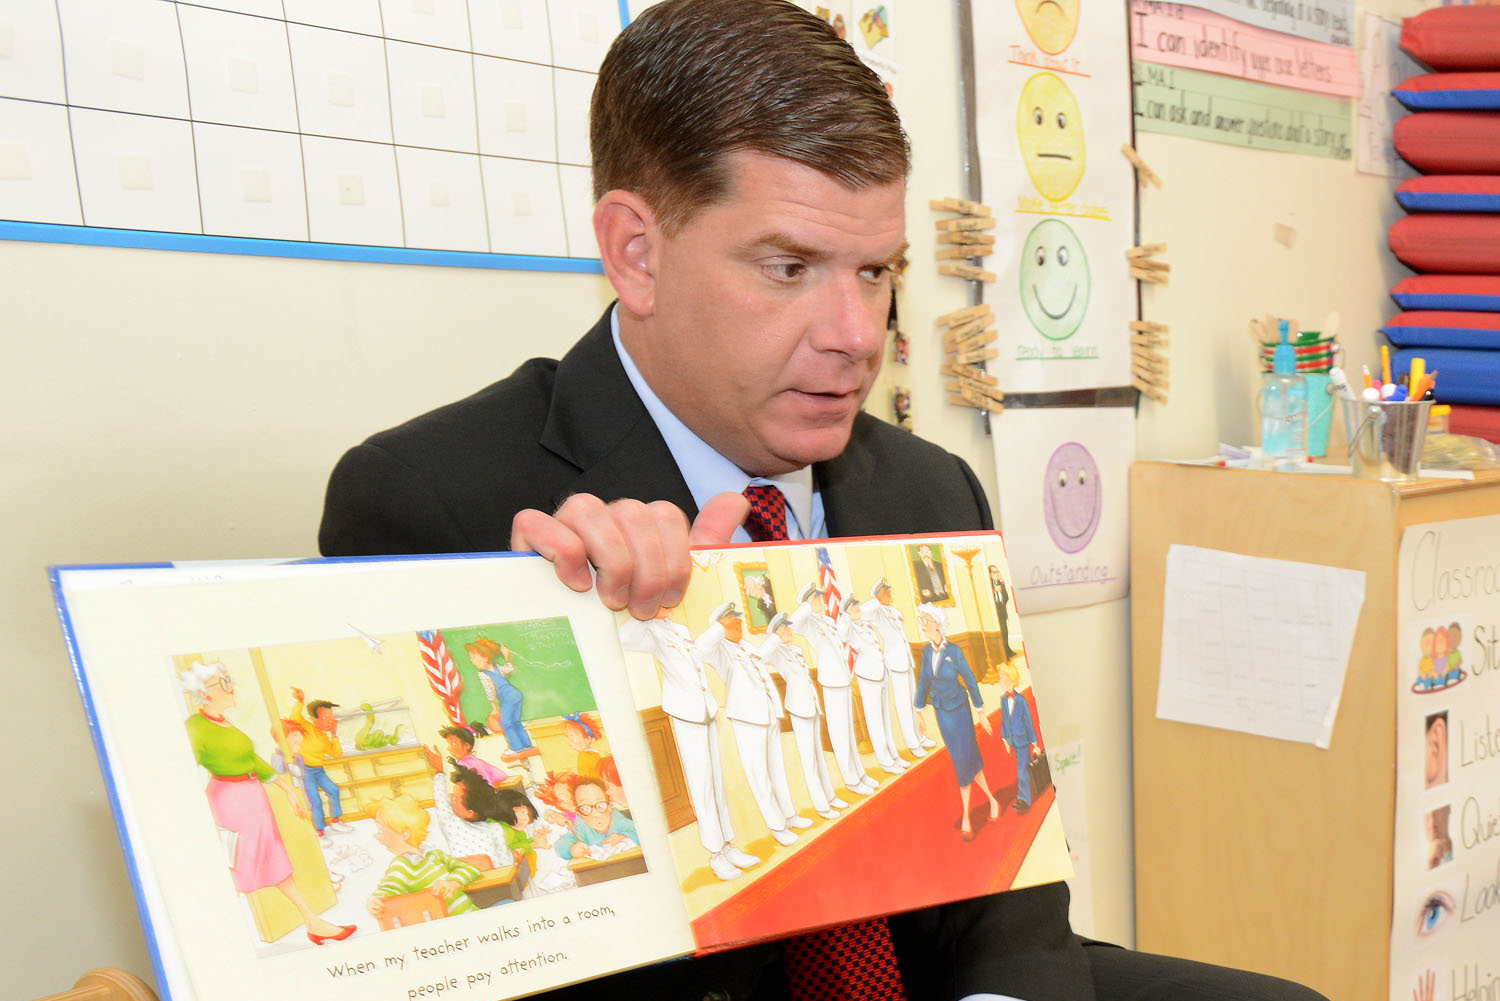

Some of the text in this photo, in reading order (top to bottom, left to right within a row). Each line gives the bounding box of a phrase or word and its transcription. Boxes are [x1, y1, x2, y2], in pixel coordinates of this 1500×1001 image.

[1135, 11, 1148, 48] I
[1157, 31, 1186, 54] can
[1030, 562, 1110, 587] Outstanding
[1471, 624, 1500, 677] Sit
[326, 904, 615, 980] When my teacher walks into a room,
[466, 969, 493, 990] pay
[499, 951, 568, 976] attention.
